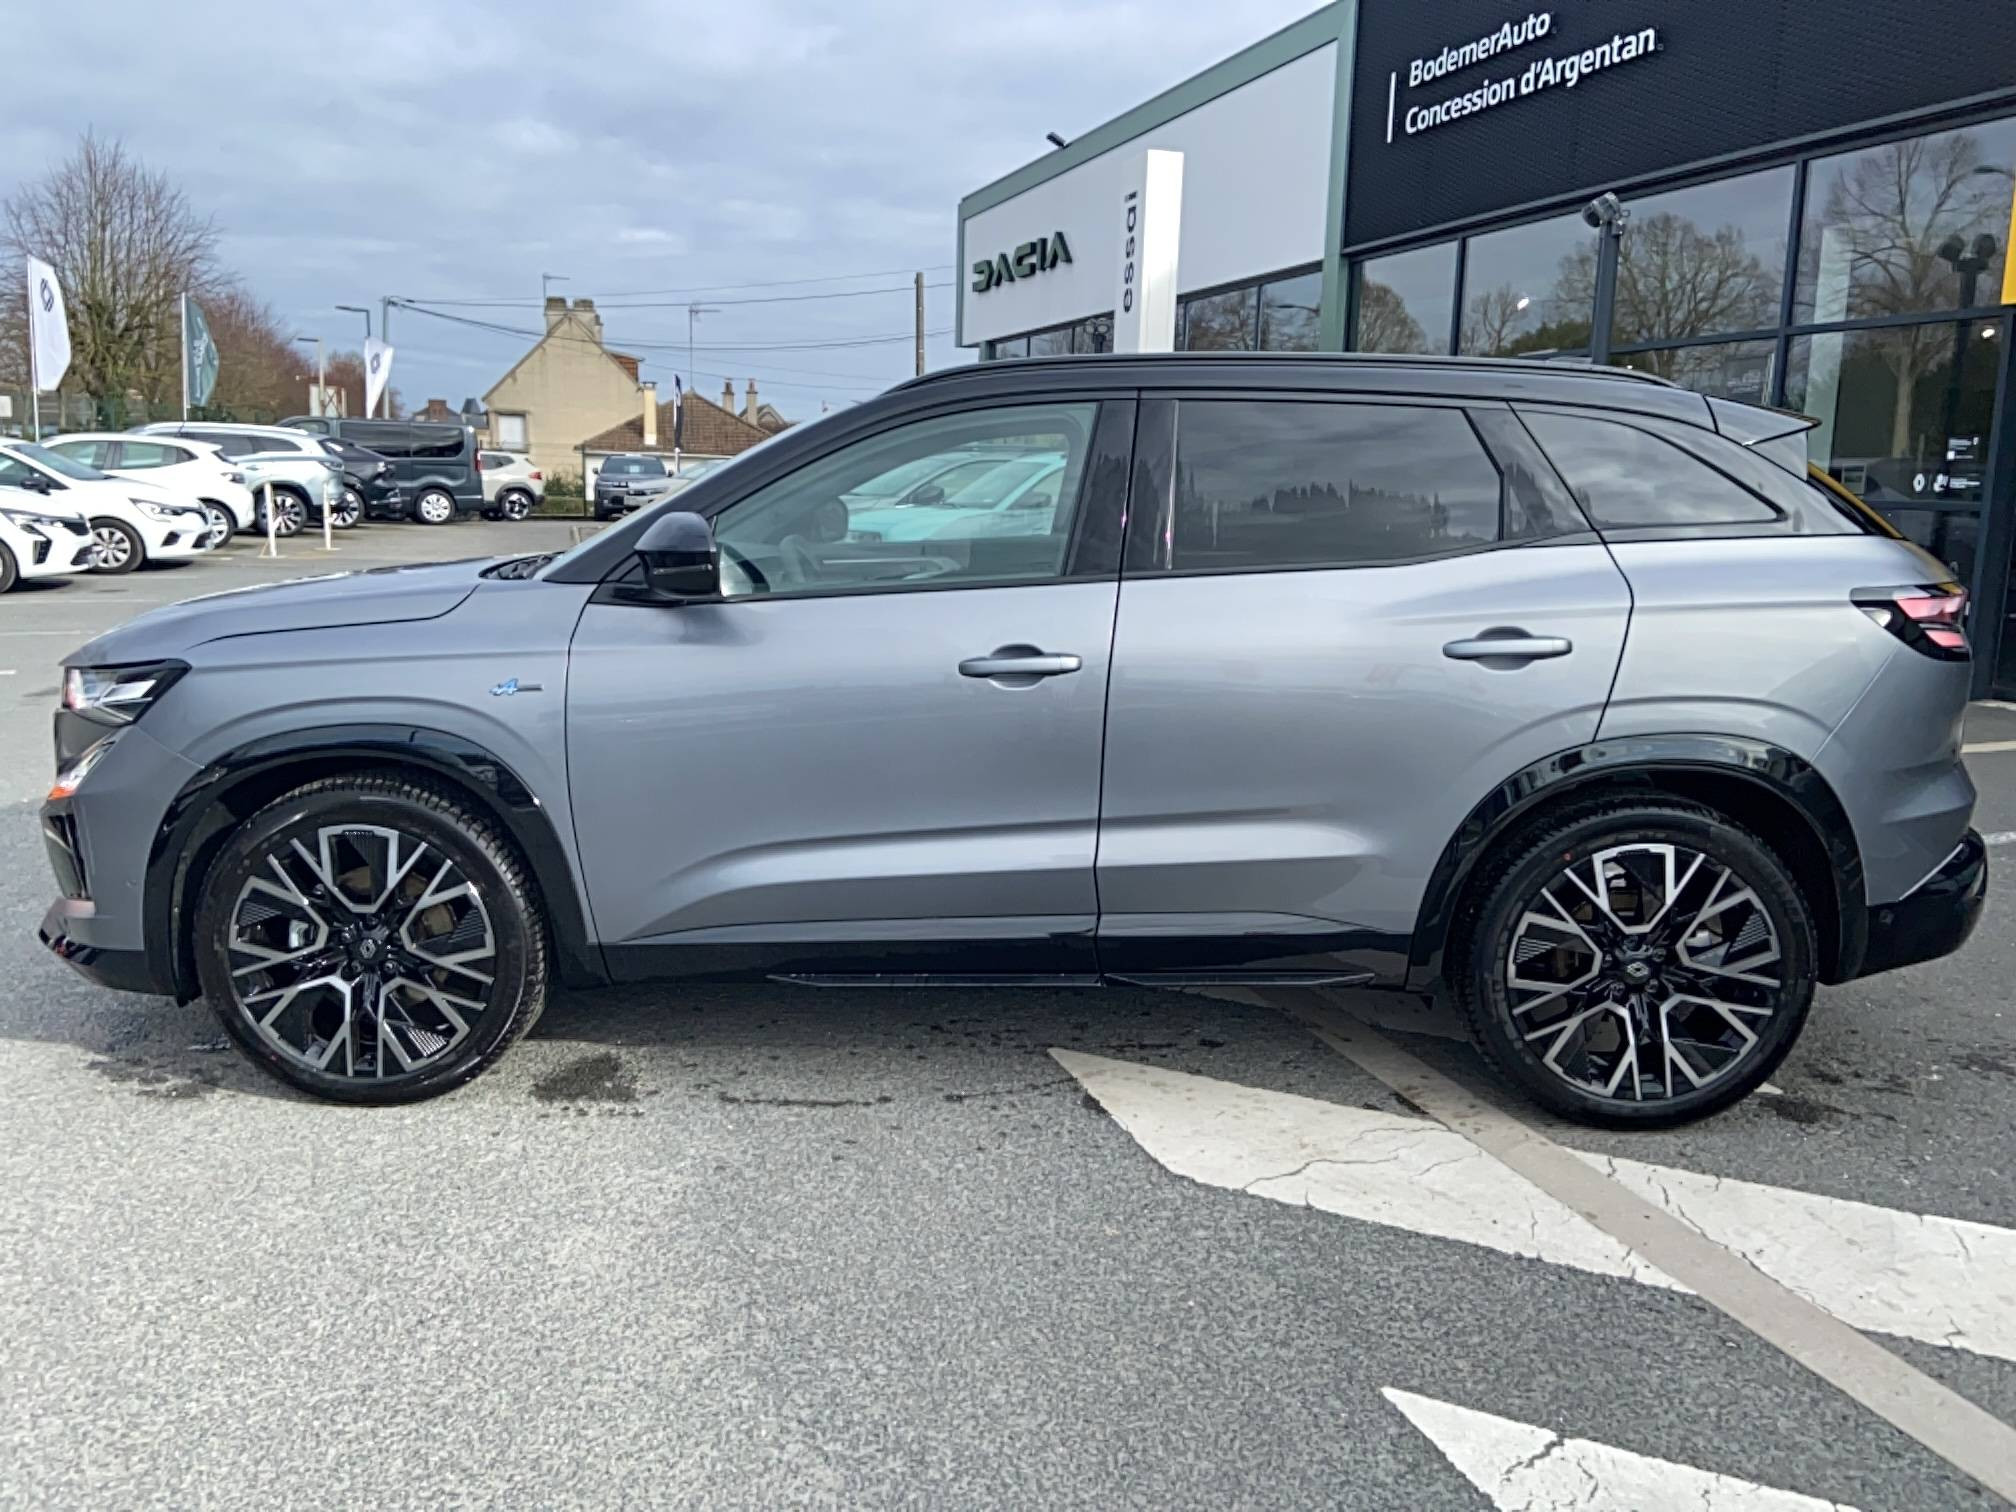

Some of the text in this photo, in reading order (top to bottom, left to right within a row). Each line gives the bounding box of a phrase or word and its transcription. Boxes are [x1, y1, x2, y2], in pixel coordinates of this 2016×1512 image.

[1405, 27, 1656, 135] Concession d'Argentan
[1408, 12, 1552, 88] BodemerAuto
[972, 231, 1072, 292] DACIA
[1123, 190, 1138, 313] essai
